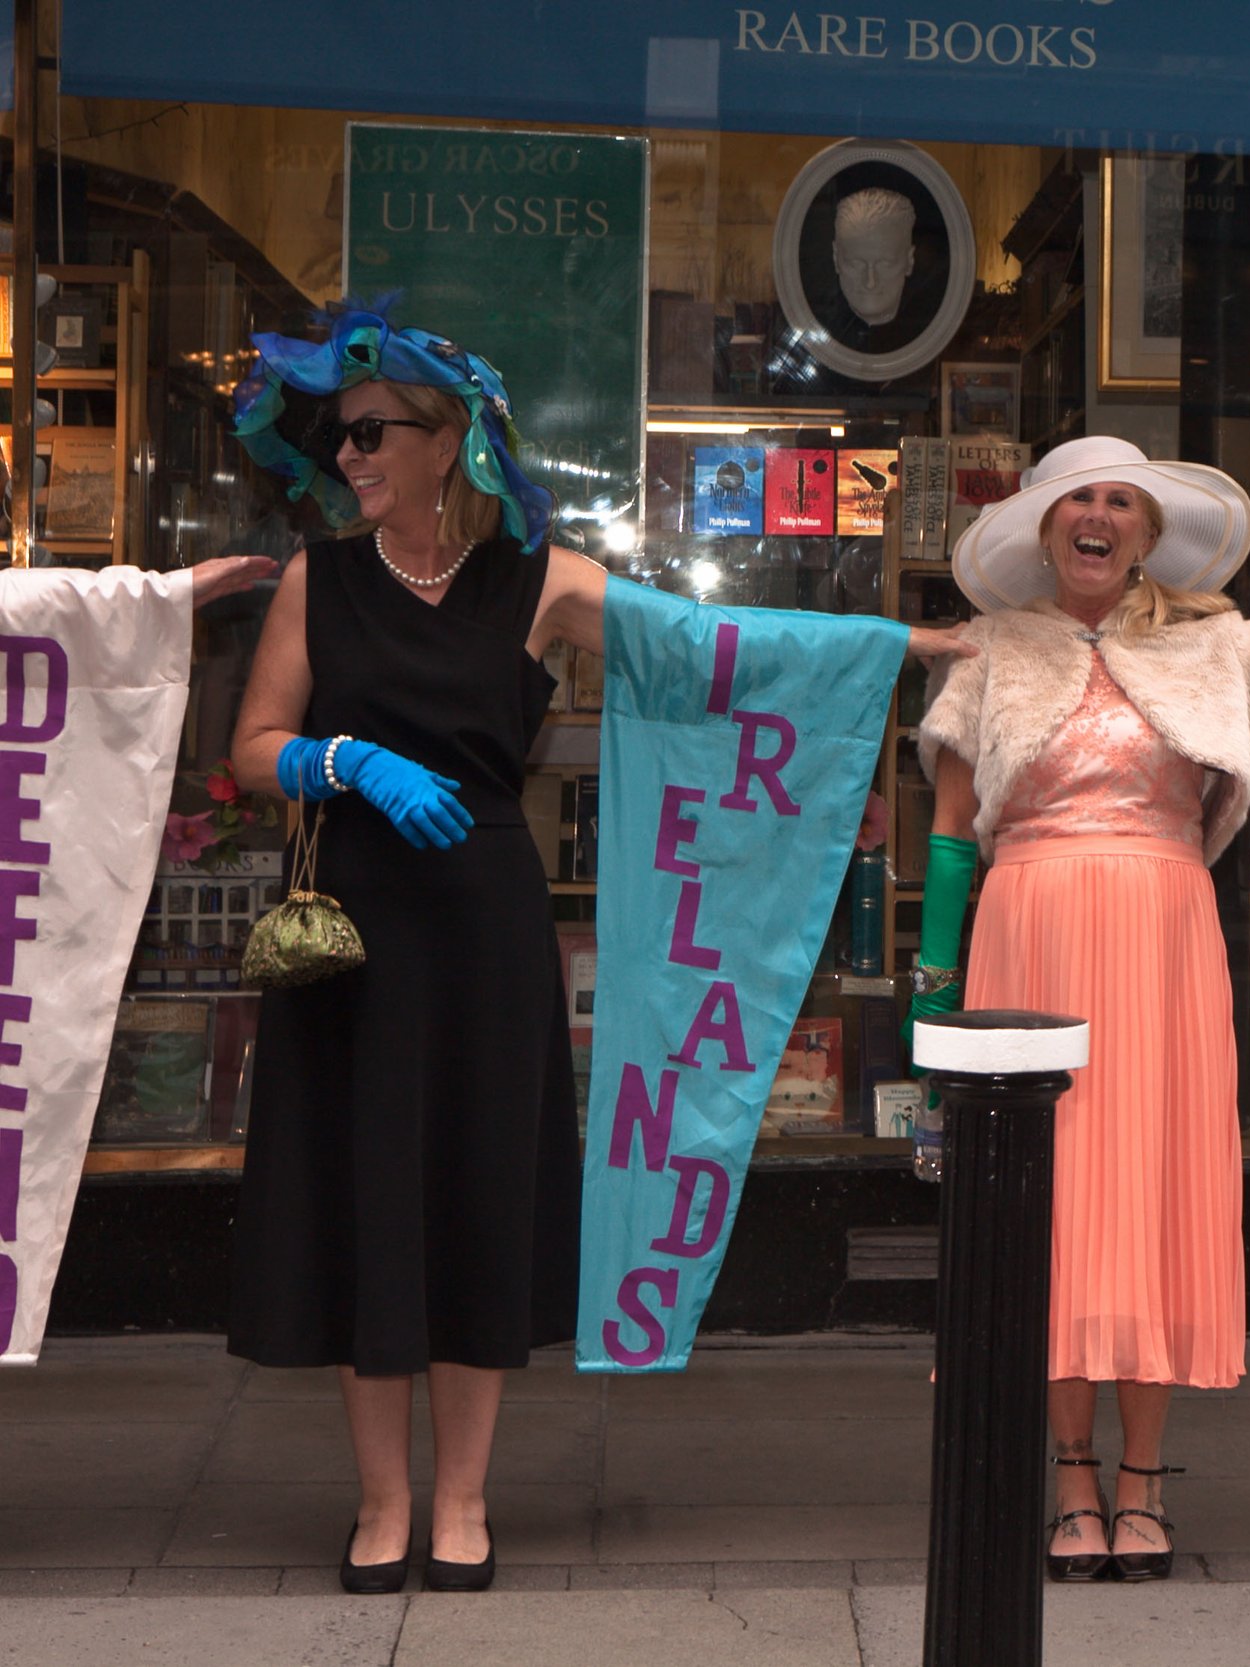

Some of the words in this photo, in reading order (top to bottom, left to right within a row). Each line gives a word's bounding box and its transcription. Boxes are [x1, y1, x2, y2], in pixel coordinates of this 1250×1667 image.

[733, 8, 888, 59] RARE
[904, 18, 1098, 70] BOOKS
[382, 191, 610, 239] ULYSSES
[958, 446, 1021, 461] LETTERS
[852, 487, 866, 500] The
[708, 517, 726, 528] Philip
[726, 517, 751, 528] Pullman
[780, 517, 796, 528] Philip
[797, 517, 821, 528] Pullman
[852, 518, 870, 529] Philip
[602, 622, 802, 1368] IRELANDS
